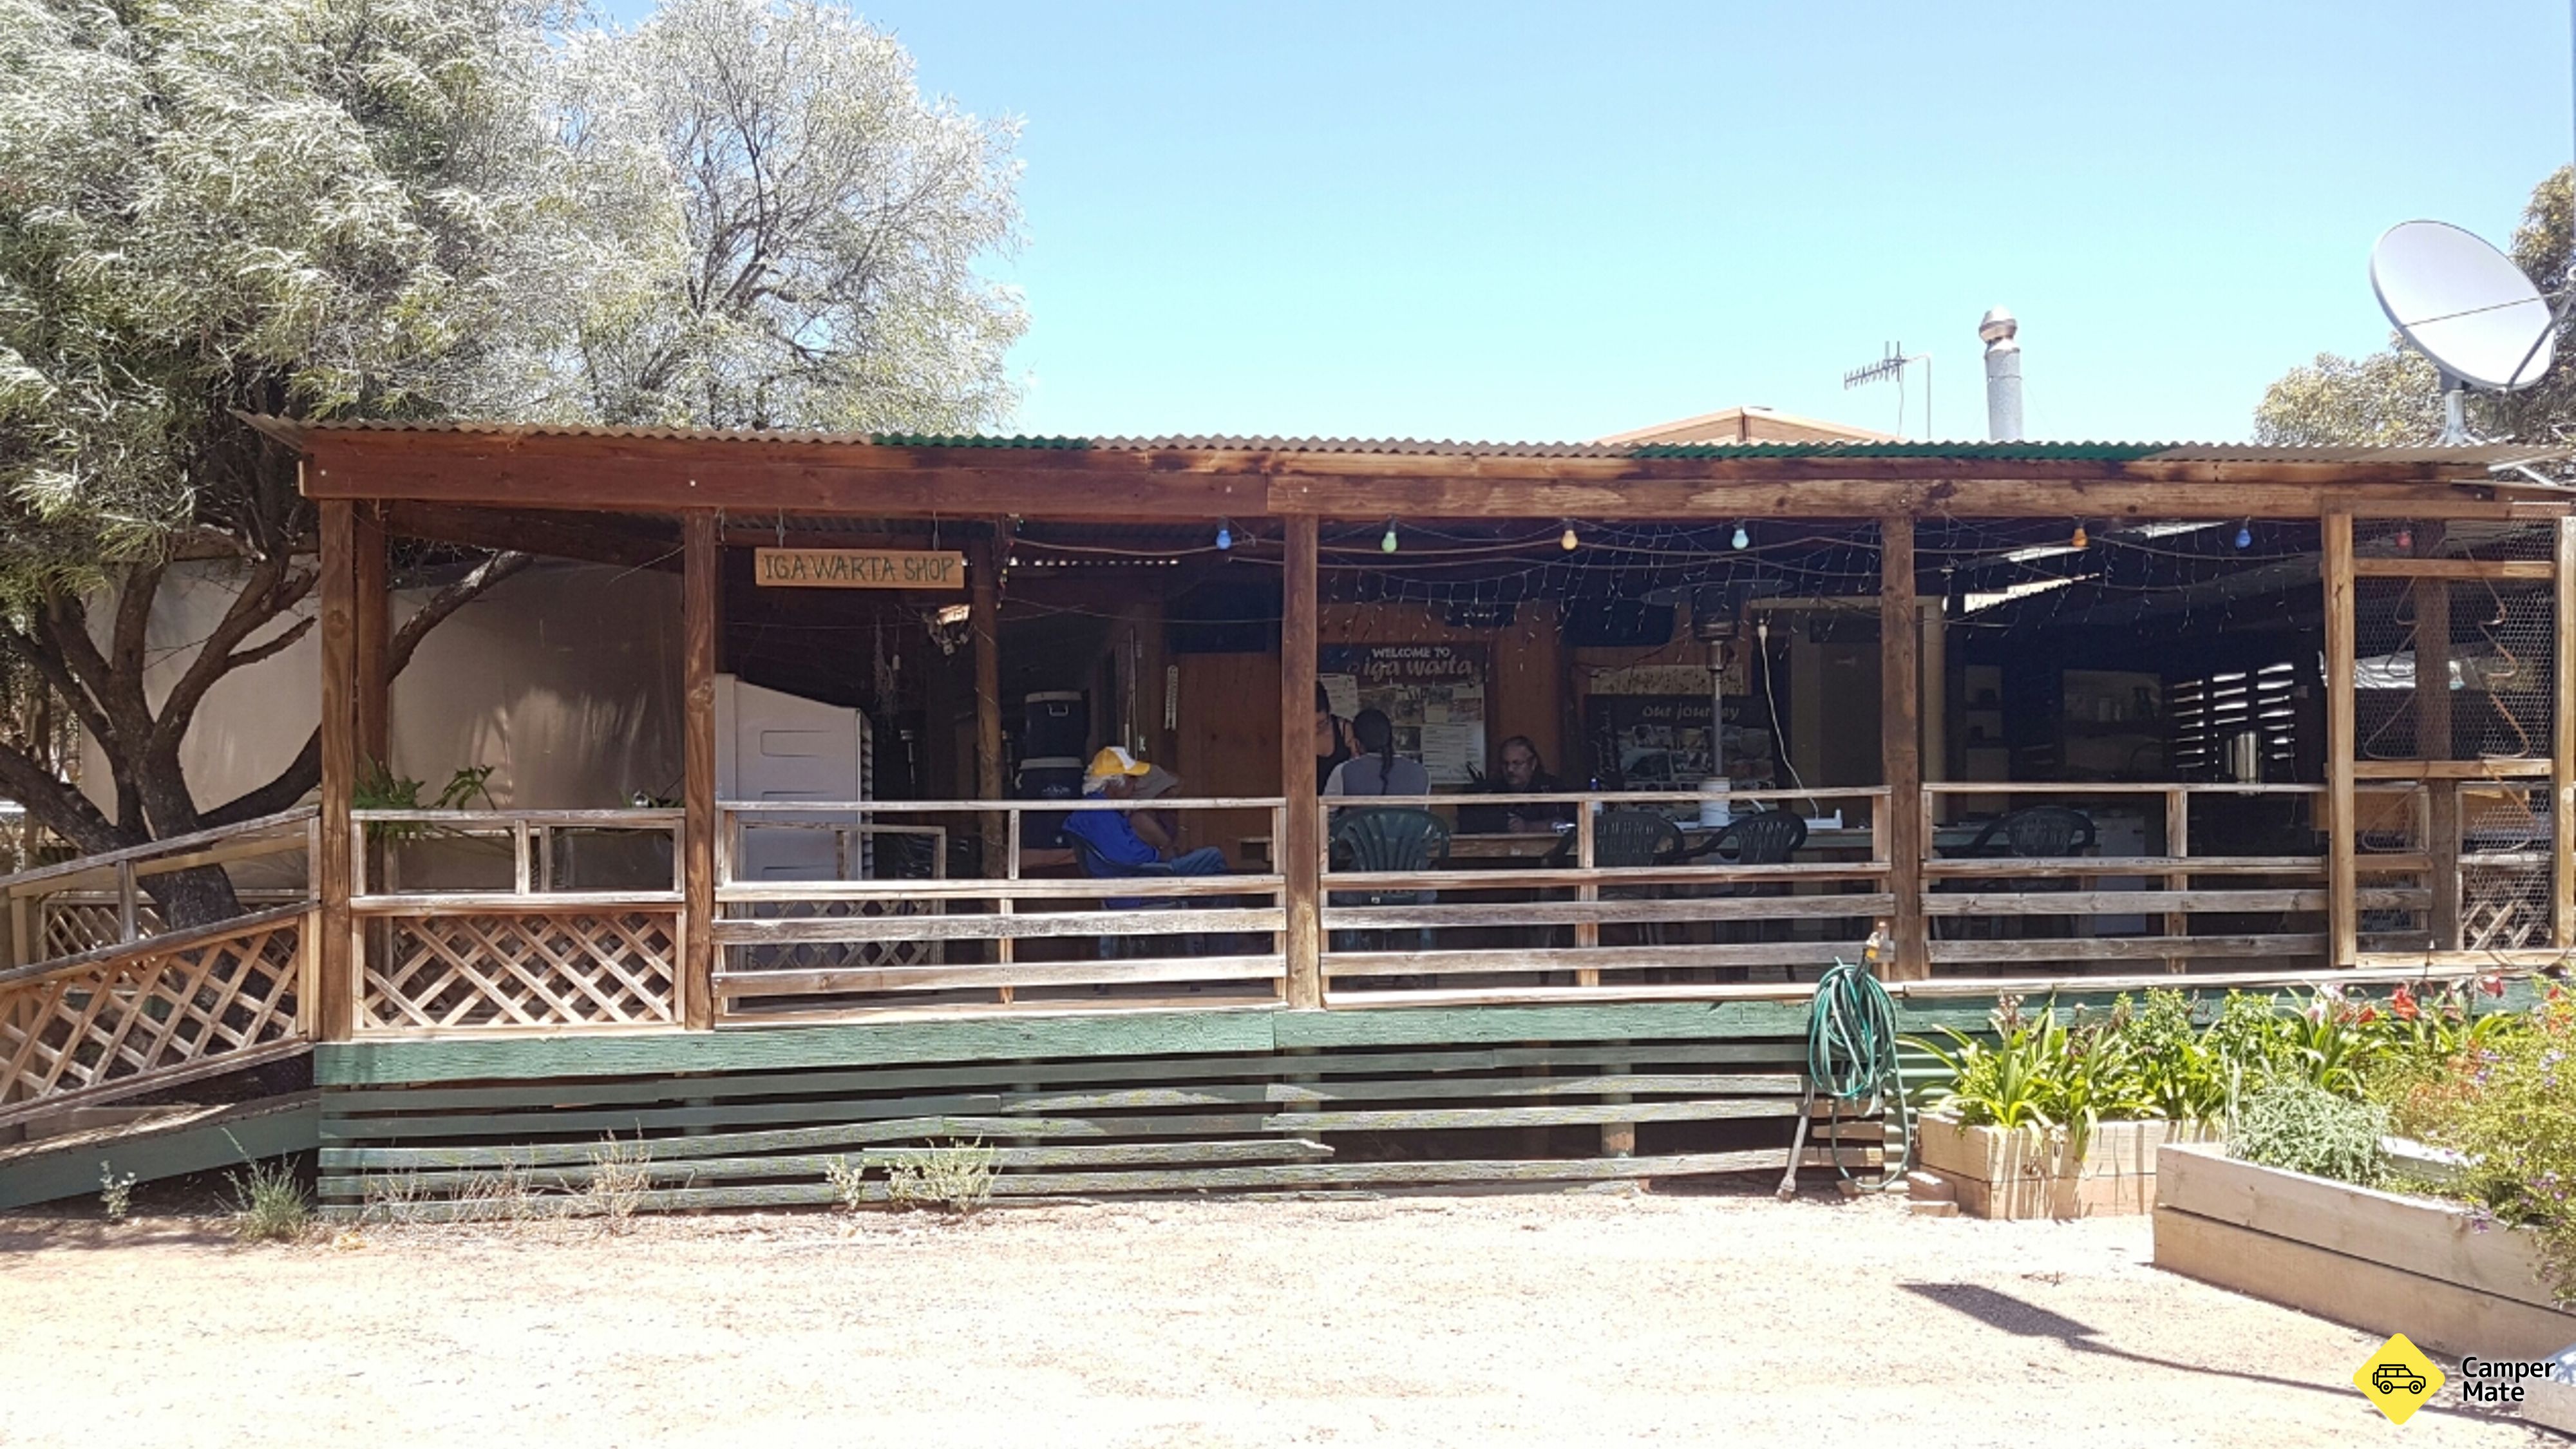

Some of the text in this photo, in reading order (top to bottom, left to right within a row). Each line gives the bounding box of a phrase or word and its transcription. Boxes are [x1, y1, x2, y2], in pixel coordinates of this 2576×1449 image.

[764, 555, 954, 582] IGA WARTA SHOP
[1372, 647, 1451, 658] WELCOME TO
[1363, 654, 1473, 682] iga warta
[1676, 701, 1740, 722] jourey
